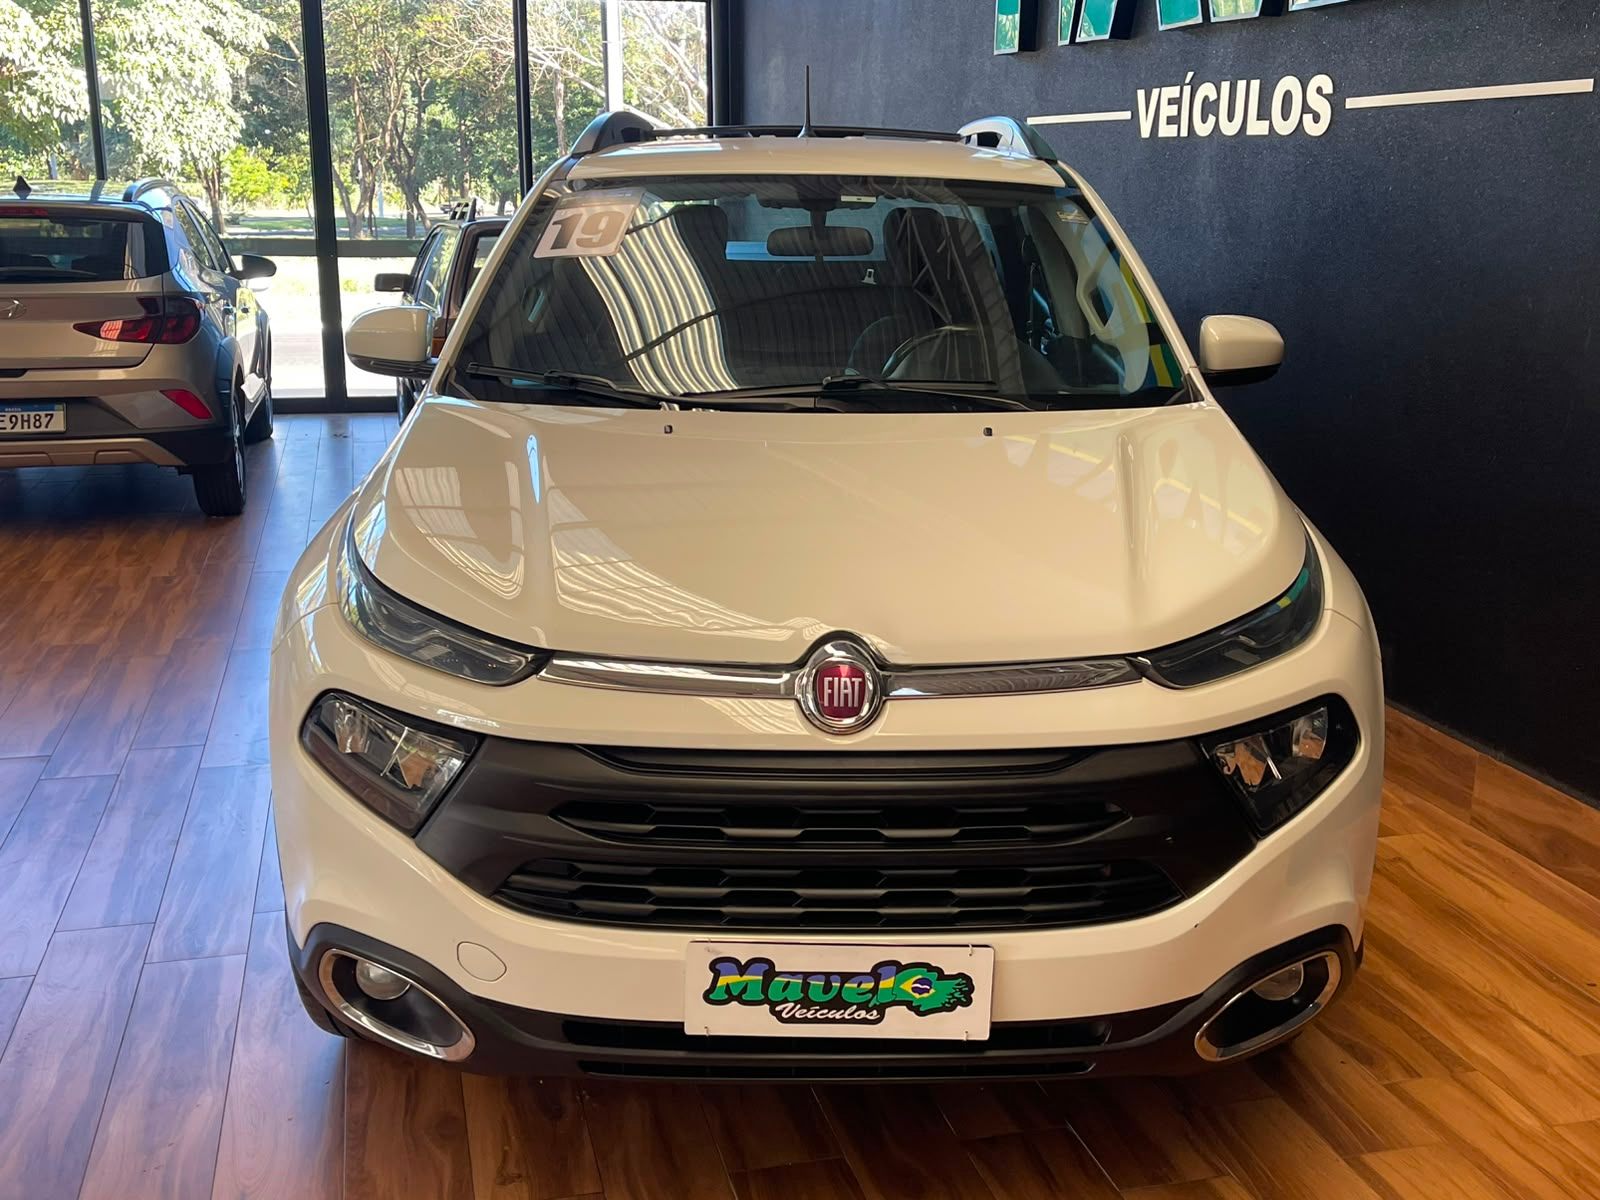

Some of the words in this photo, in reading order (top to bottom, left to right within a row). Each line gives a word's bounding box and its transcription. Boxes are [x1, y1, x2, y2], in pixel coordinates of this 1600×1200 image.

[1136, 71, 1334, 138] VEÍCULOS
[550, 211, 625, 250] 19
[823, 677, 862, 708] FIAT
[707, 960, 899, 1006] Mavel
[774, 1003, 881, 1021] Veículos
